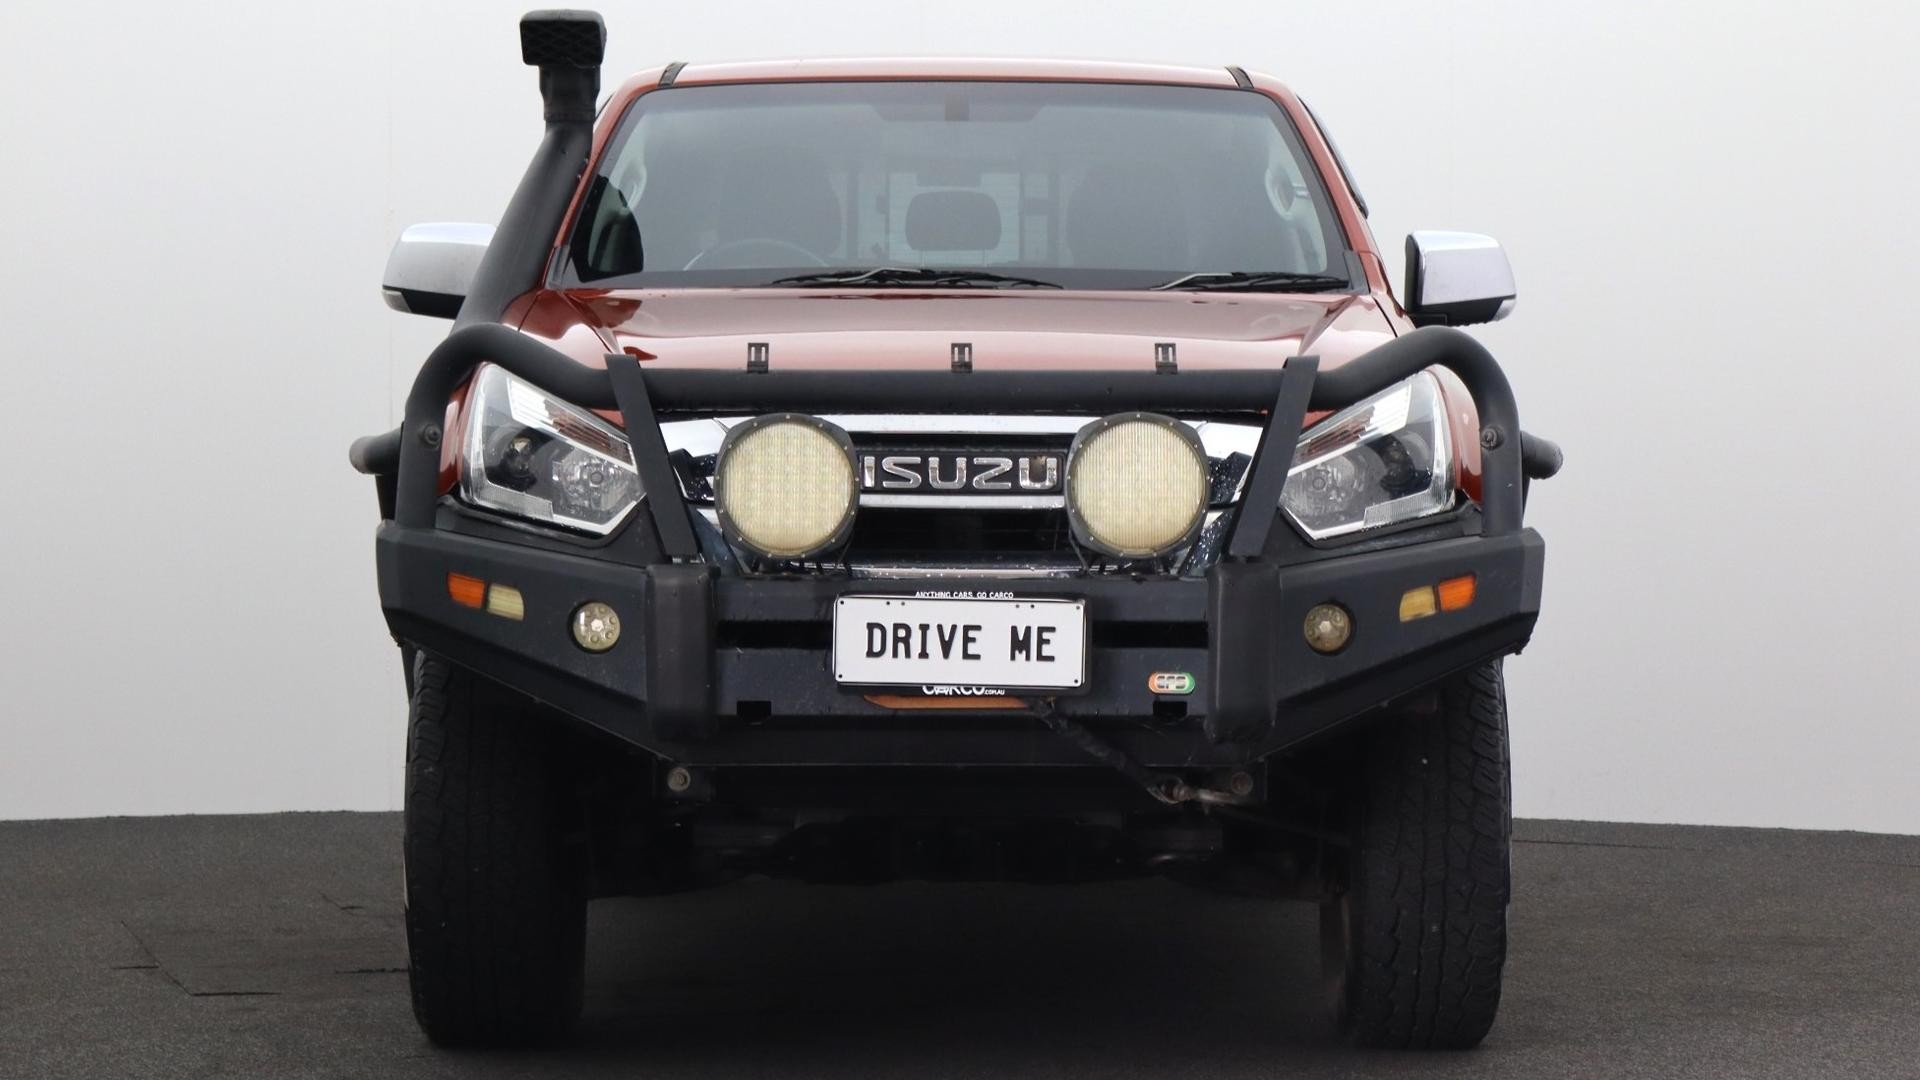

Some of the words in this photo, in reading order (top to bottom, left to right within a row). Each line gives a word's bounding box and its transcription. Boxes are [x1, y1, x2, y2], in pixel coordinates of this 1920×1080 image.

[863, 456, 1058, 490] ISUZU
[915, 591, 951, 599] ANYTHING
[976, 591, 988, 599] GO
[989, 591, 1014, 599] CARCO
[865, 622, 983, 660] DRIVE
[1009, 625, 1057, 662] ME
